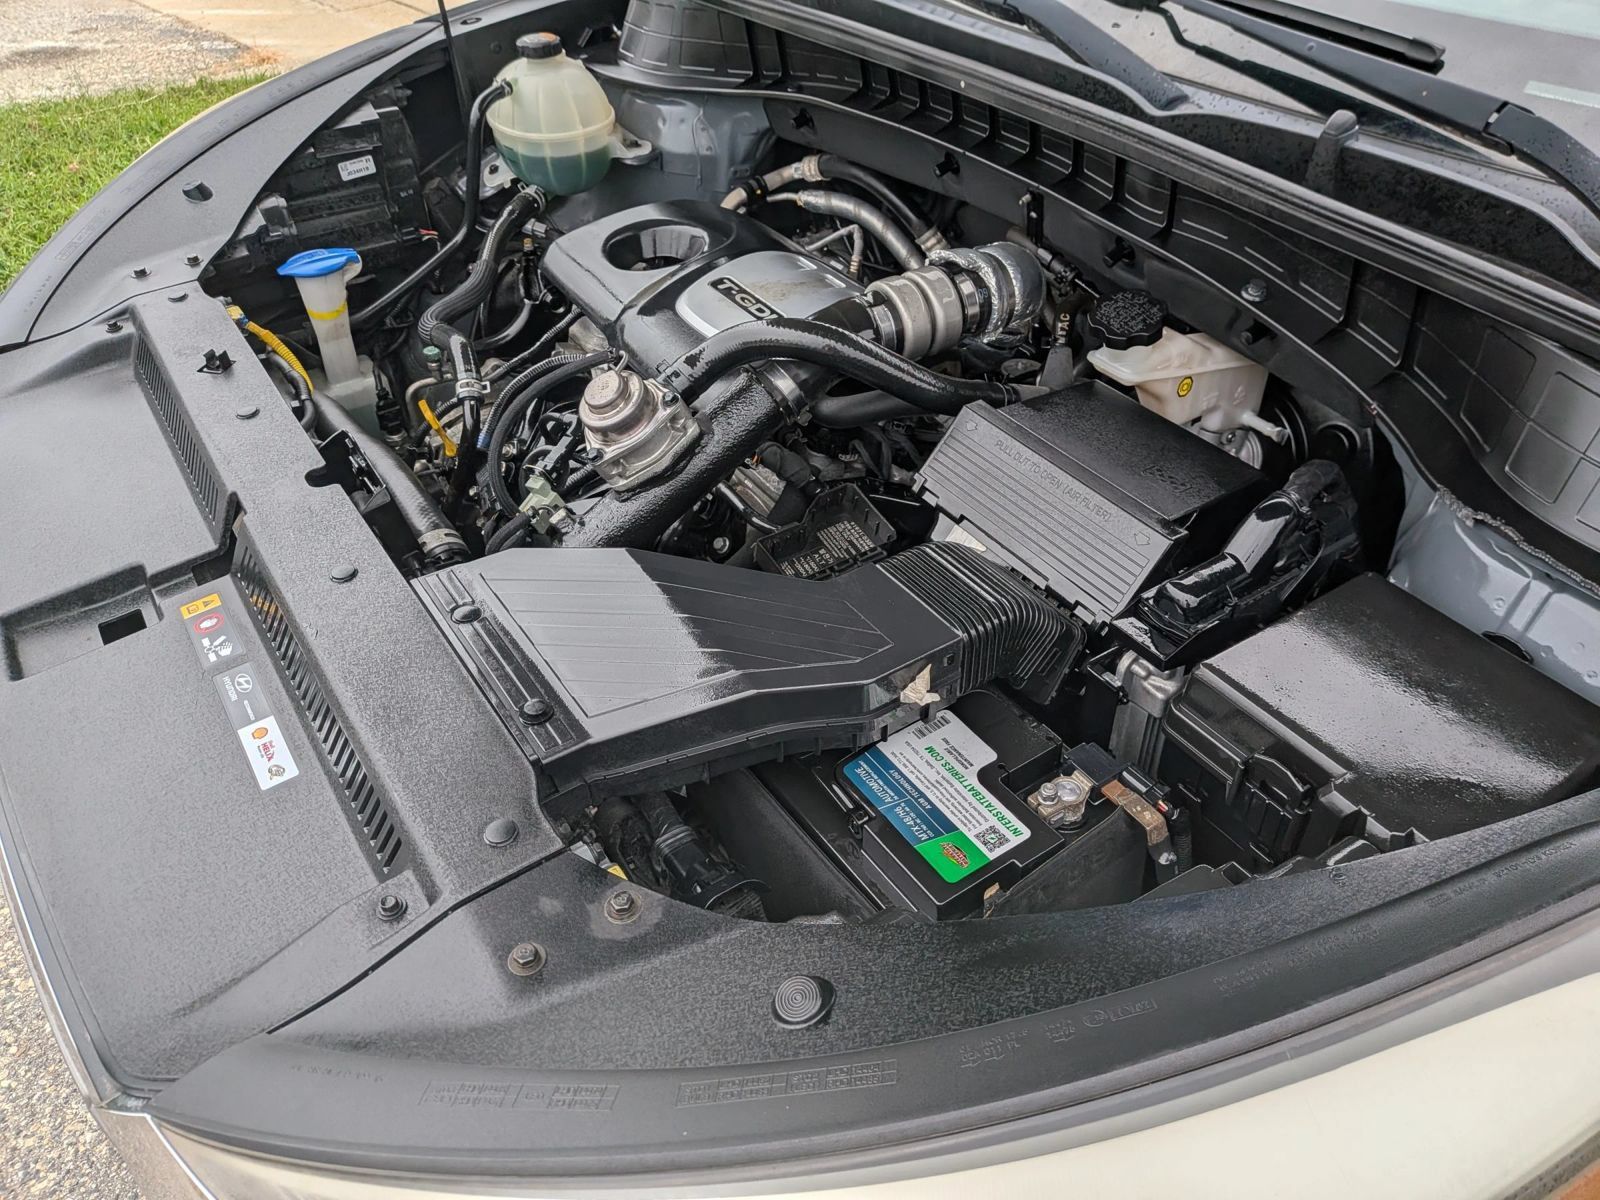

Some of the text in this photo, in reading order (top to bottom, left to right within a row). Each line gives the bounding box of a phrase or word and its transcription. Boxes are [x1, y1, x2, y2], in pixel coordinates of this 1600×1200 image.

[995, 440, 1012, 457] PULL
[1013, 452, 1029, 466] OUT
[1029, 461, 1042, 474] TO
[1040, 469, 1063, 489] OPEN
[813, 554, 826, 565] ALT
[221, 675, 237, 701] HYUNDAI
[260, 742, 274, 762] HELIX
[854, 765, 893, 804] AUTOMOTIVE
[888, 767, 932, 809] AGM TECHNOLOGY
[924, 744, 1023, 837] INTERSTATEBATTERIES.COM
[893, 805, 929, 841] MTX-48/H6
